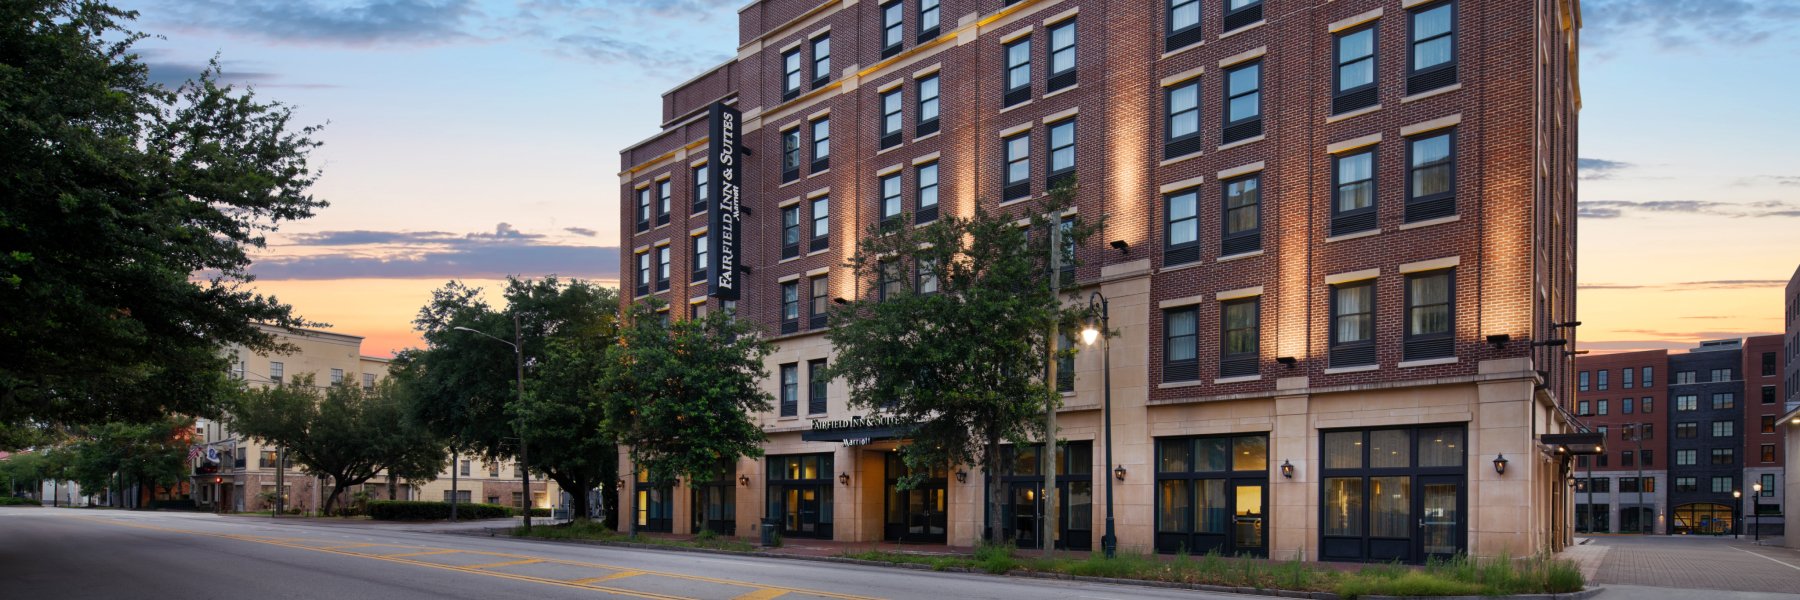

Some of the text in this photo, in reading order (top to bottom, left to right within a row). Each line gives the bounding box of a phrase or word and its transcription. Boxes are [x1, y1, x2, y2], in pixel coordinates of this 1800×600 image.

[719, 113, 733, 290] FAIRFIELD INN & SUITES
[811, 419, 849, 430] FAIRFIELD
[850, 417, 866, 428] INN
[866, 419, 874, 427] &
[842, 437, 870, 447] Marriott
